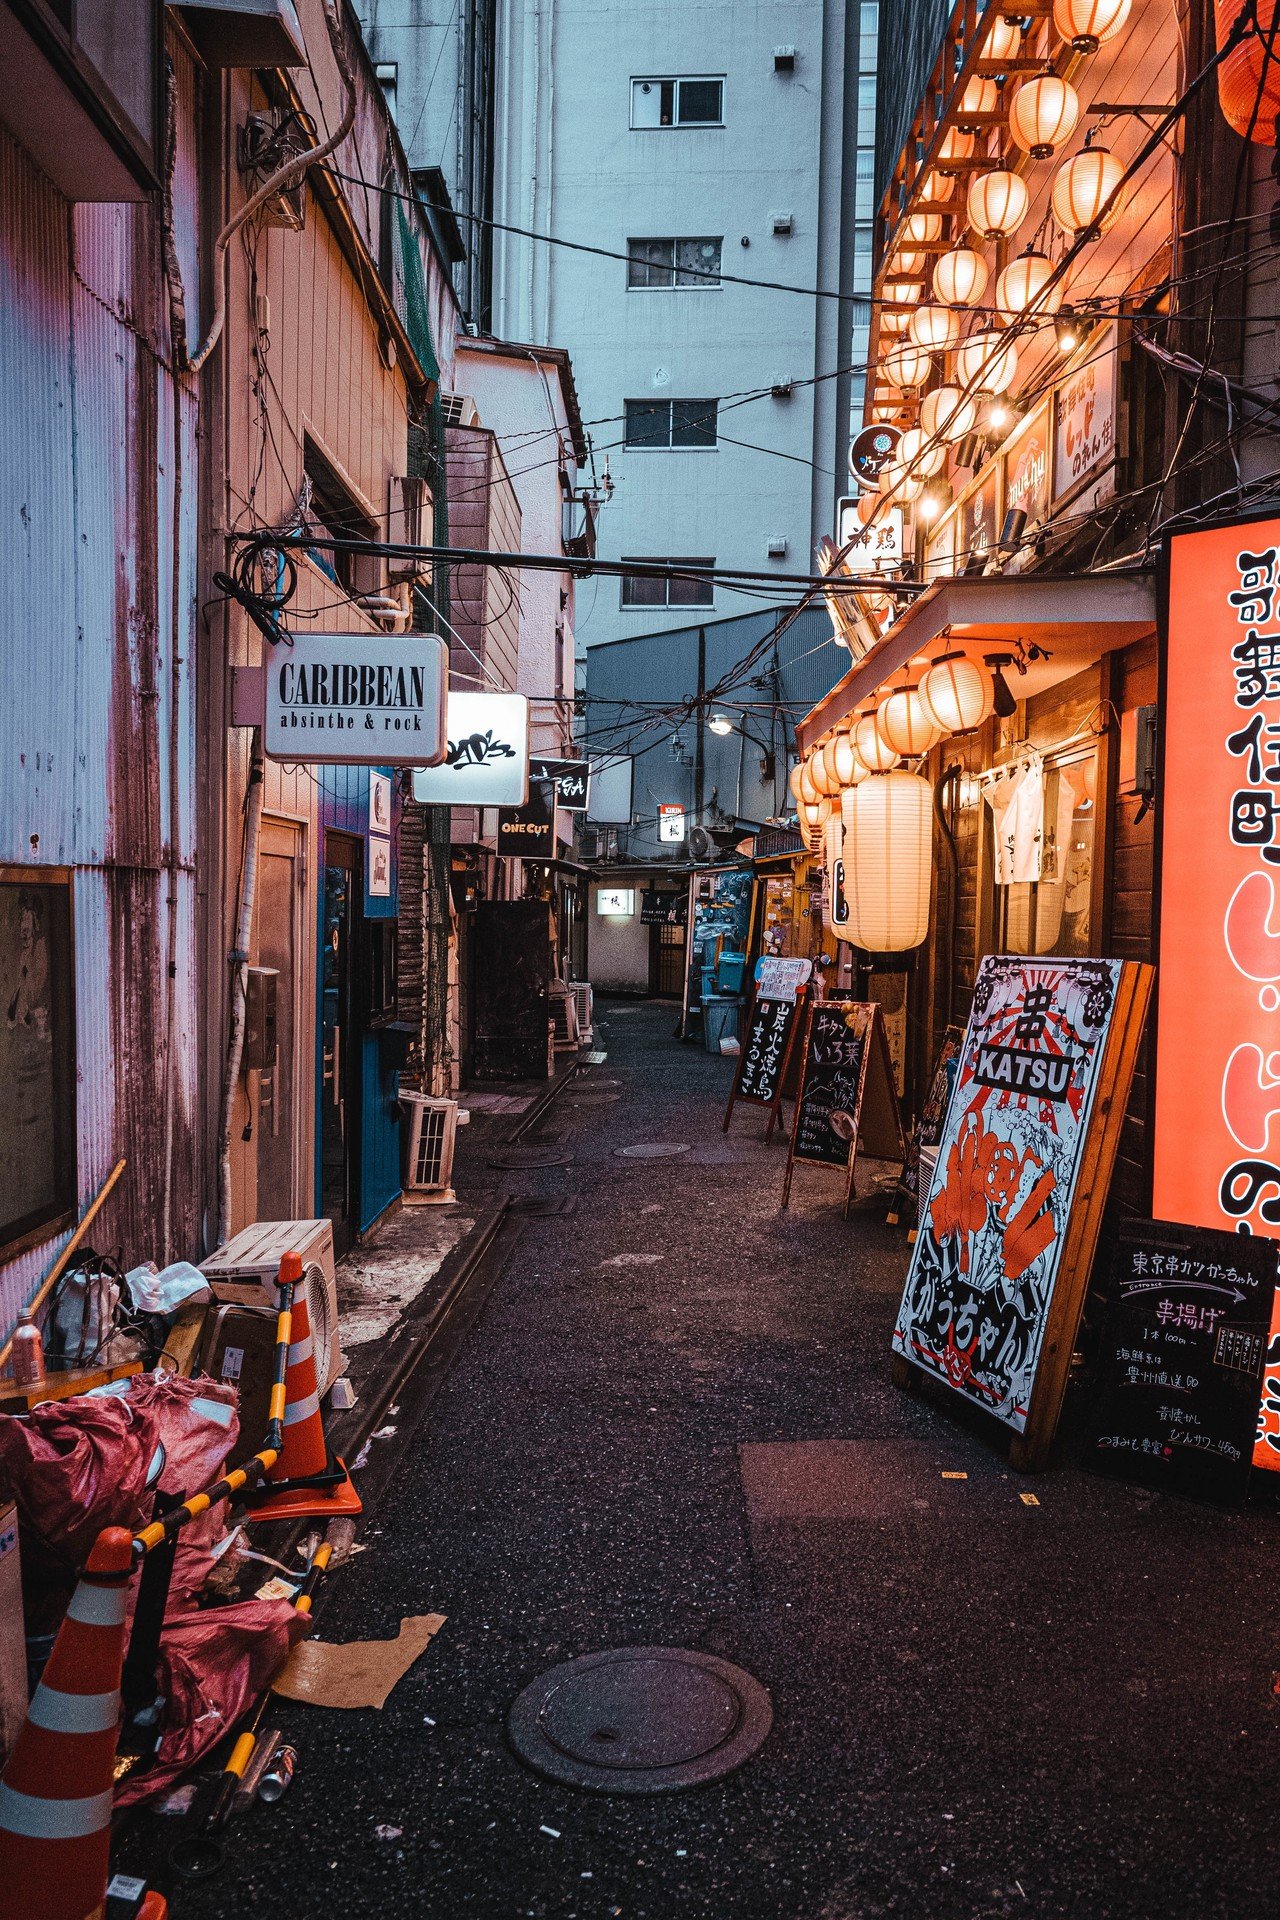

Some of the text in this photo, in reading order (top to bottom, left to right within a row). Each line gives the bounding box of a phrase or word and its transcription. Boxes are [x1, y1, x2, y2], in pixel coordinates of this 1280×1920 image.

[279, 662, 426, 708] CARIBBEAN
[280, 711, 423, 732] absinthe & rock
[501, 822, 549, 835] ONE CUT
[1014, 982, 1053, 1048] 串
[977, 1049, 1070, 1094] KATSU
[1156, 1299, 1226, 1334] 串揚げ
